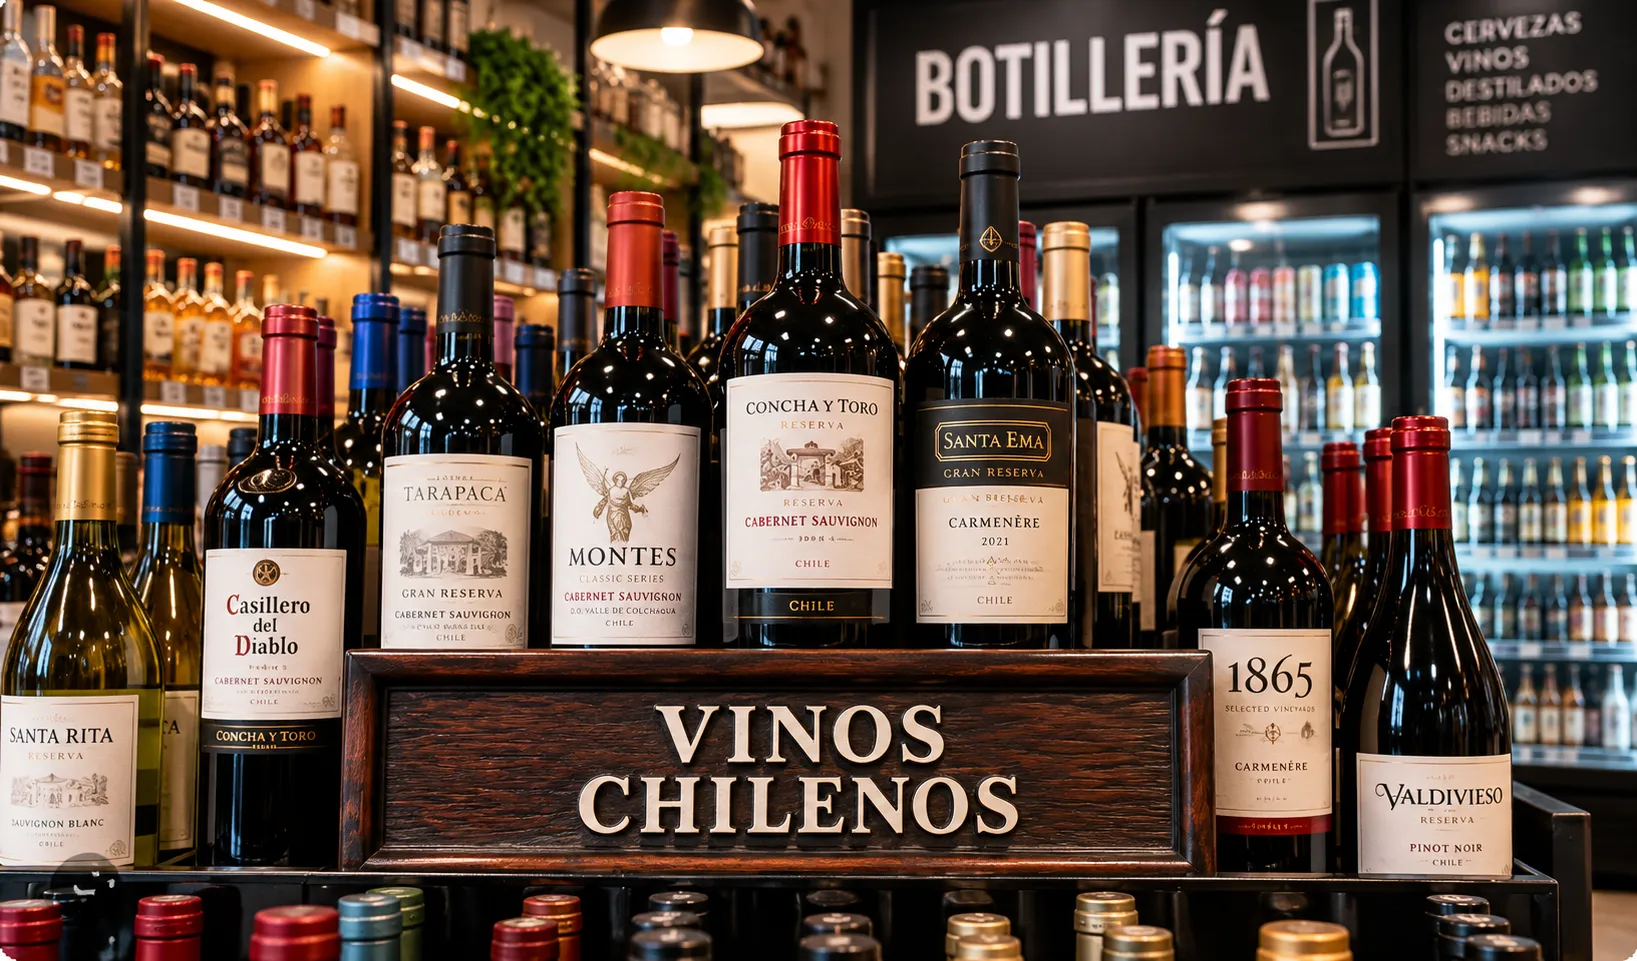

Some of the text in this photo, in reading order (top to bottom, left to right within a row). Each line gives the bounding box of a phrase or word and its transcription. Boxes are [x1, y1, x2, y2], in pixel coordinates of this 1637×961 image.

[1444, 10, 1583, 45] CERVEZAS
[1444, 45, 1530, 74] VINOS
[916, 9, 1270, 126] BOTILLERÍA
[1445, 68, 1599, 103] DESTILADOS
[1445, 99, 1552, 130] BEBIDAS
[1445, 127, 1549, 156] SNACKS
[746, 398, 878, 416] CONCHA Y TORO
[781, 420, 844, 430] RESERVA
[944, 431, 1045, 449] SANTA EMA
[987, 468, 1044, 478] RESERVA
[783, 499, 843, 507] RESERVA
[744, 516, 878, 528] CABERNET SAUVIGNON
[981, 537, 1009, 546] 2021
[568, 546, 677, 567] MONTES
[795, 560, 830, 568] CHILE
[579, 574, 664, 583] CLASSIC SERIES
[402, 589, 503, 598] GRAN RESERVA
[564, 591, 614, 601] CABERNET
[226, 594, 310, 615] Casillero
[789, 600, 834, 612] CHILE
[977, 596, 1013, 605] CHILE
[395, 610, 445, 619] CABERNET
[585, 607, 609, 615] VALLE
[612, 607, 624, 615] DE
[253, 618, 277, 633] del
[235, 634, 298, 656] Diablo
[214, 677, 322, 685] CABERNET SAUVIGNON
[1228, 653, 1313, 699] 1865
[10, 727, 114, 744] SANTA RITA
[216, 730, 316, 742] CONCHA Y TORO
[655, 704, 945, 764] VINOS
[28, 752, 84, 761] RESERVA
[1375, 783, 1503, 811] VALDIVIESO
[577, 775, 1019, 835] CHILENOS
[68, 818, 105, 828] BLANC
[1420, 816, 1475, 824] RESERVA
[1410, 843, 1483, 853] PINOT NOIR
